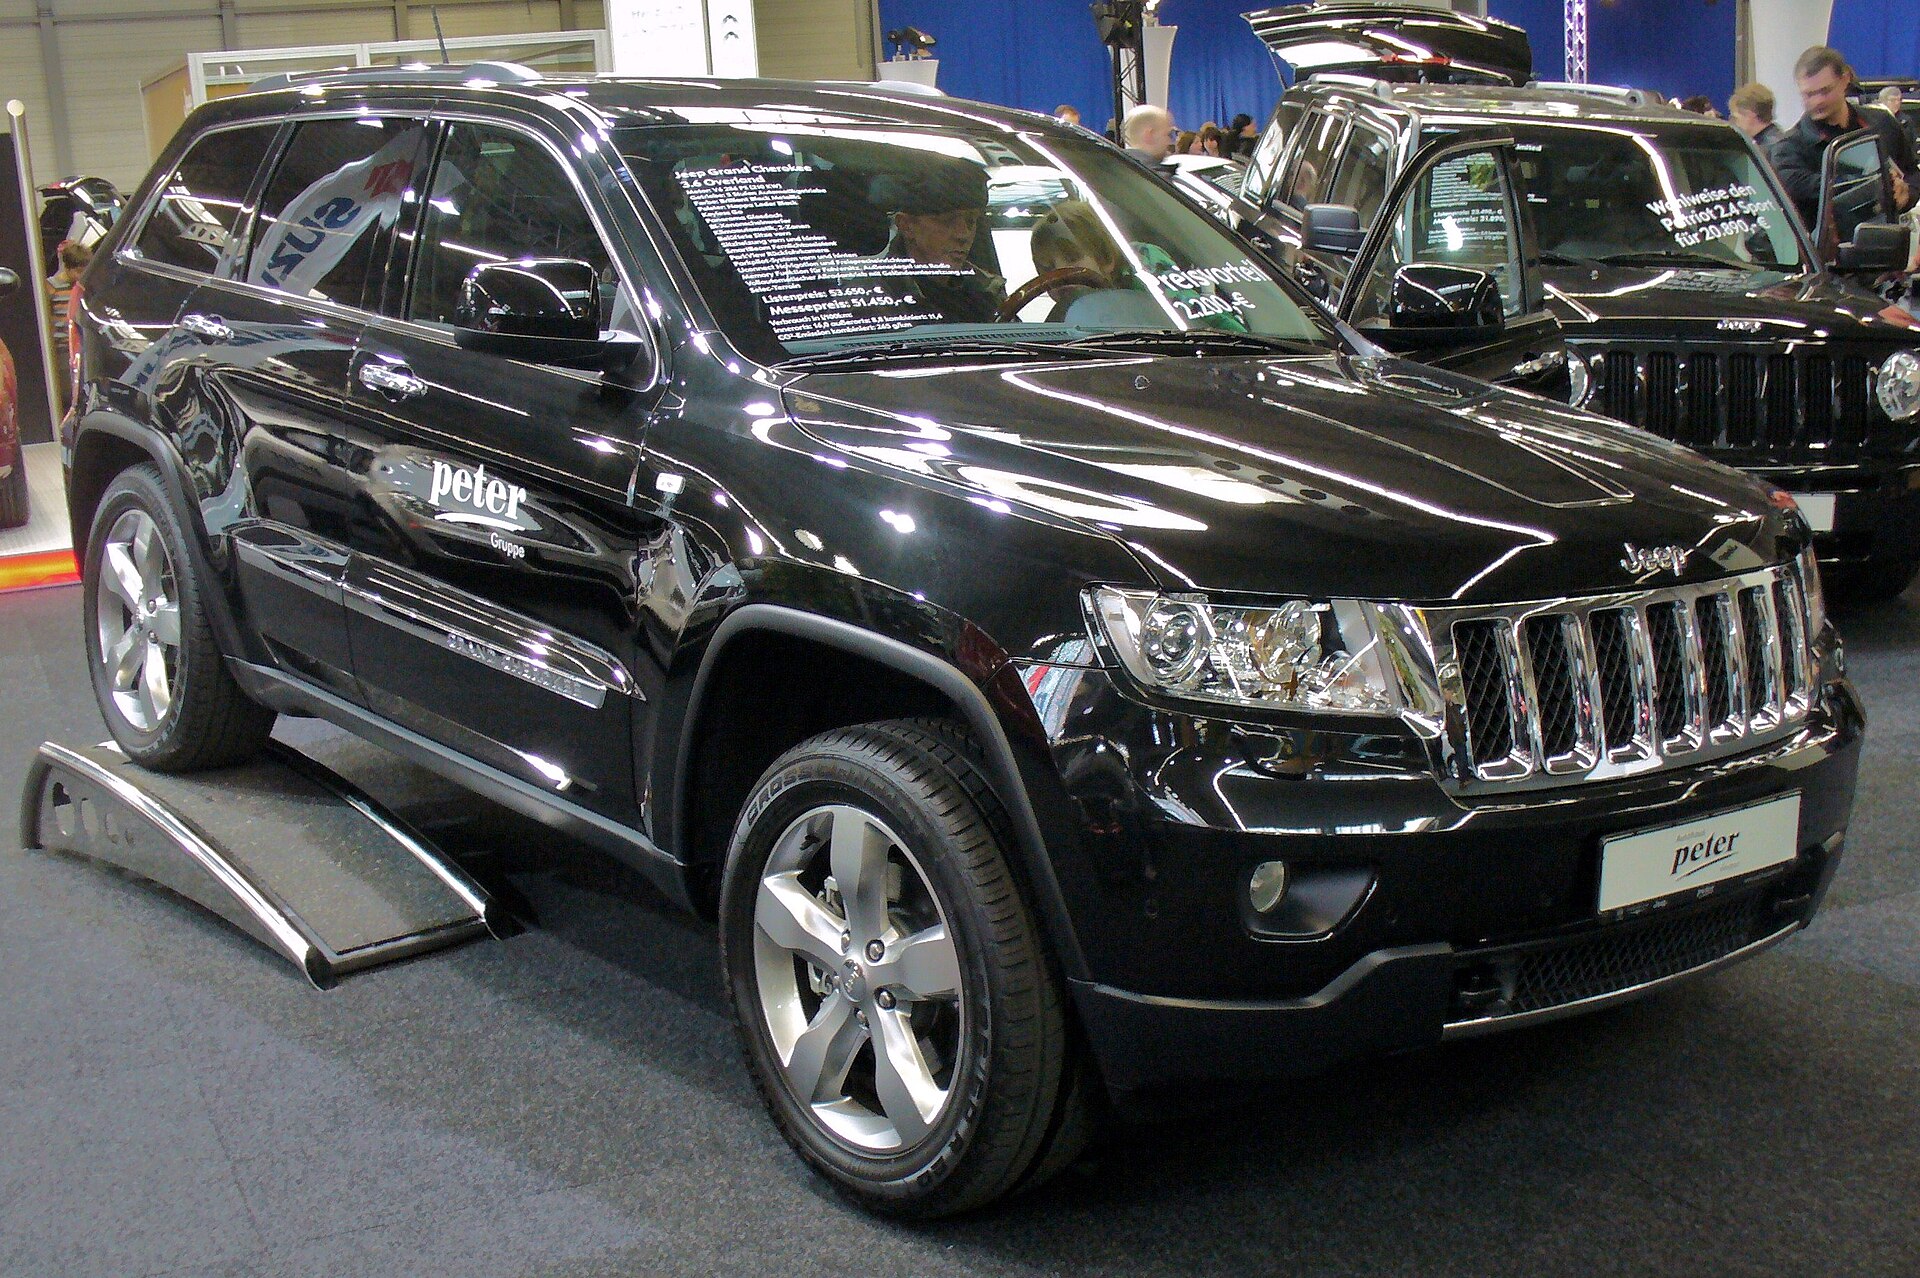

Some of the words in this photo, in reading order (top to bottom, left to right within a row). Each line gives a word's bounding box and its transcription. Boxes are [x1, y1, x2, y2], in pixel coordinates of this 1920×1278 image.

[675, 171, 706, 179] Jeep
[707, 165, 751, 176] Grand
[751, 163, 812, 173] Cherokee
[680, 180, 702, 188] 3.6
[703, 174, 766, 186] Overland
[1729, 182, 1757, 198] den
[1660, 207, 1718, 232] Patriot
[1714, 202, 1740, 218] 2.4
[1737, 199, 1776, 216] Sport
[1675, 231, 1701, 248] für
[761, 290, 828, 304] Listenpreis:
[769, 299, 851, 316] Messepreis:
[768, 316, 811, 326] Verbrauch
[428, 460, 527, 520] peter
[490, 532, 526, 559] Gruppe
[1619, 542, 1687, 577] Jeep
[1670, 832, 1740, 875] peter
